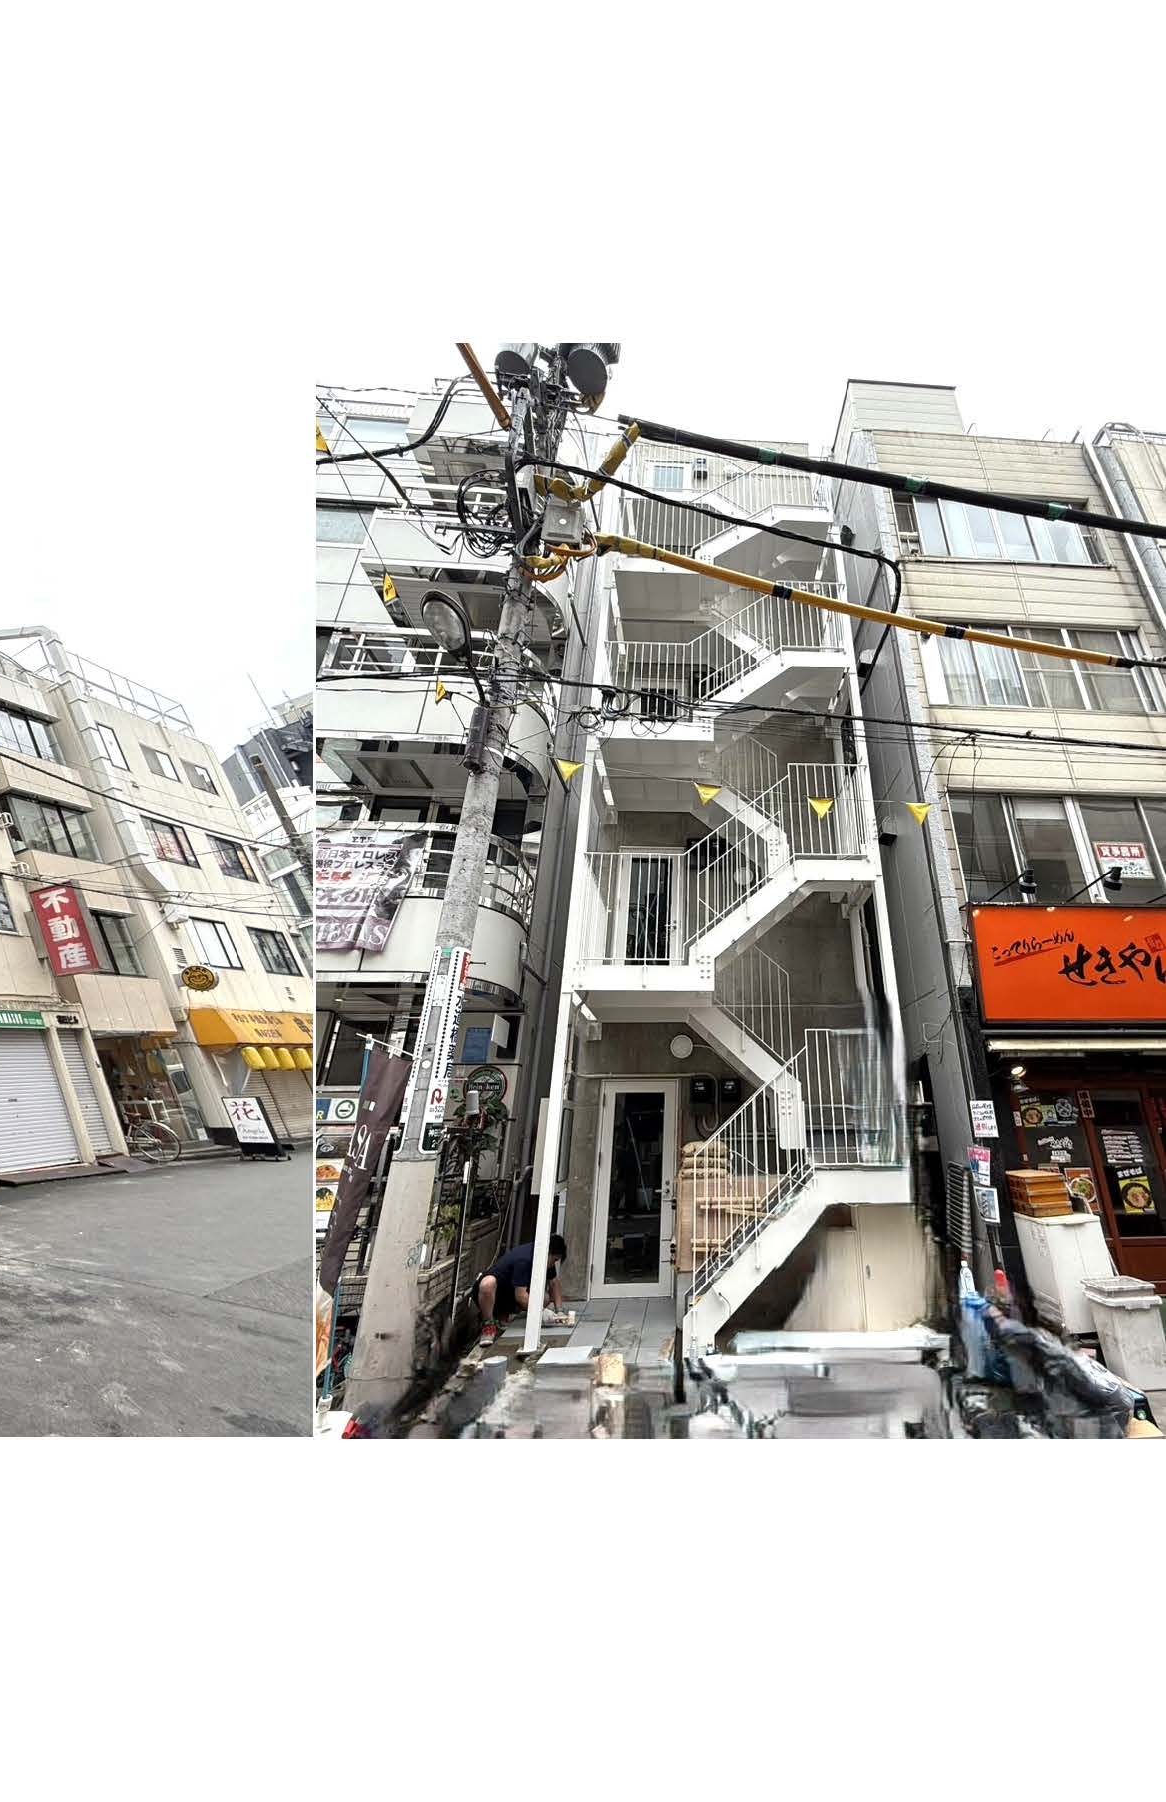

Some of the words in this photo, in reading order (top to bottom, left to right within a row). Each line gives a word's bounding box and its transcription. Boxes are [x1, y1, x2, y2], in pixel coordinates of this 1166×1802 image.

[38, 887, 91, 970] 不動産
[229, 1100, 262, 1121] 花
